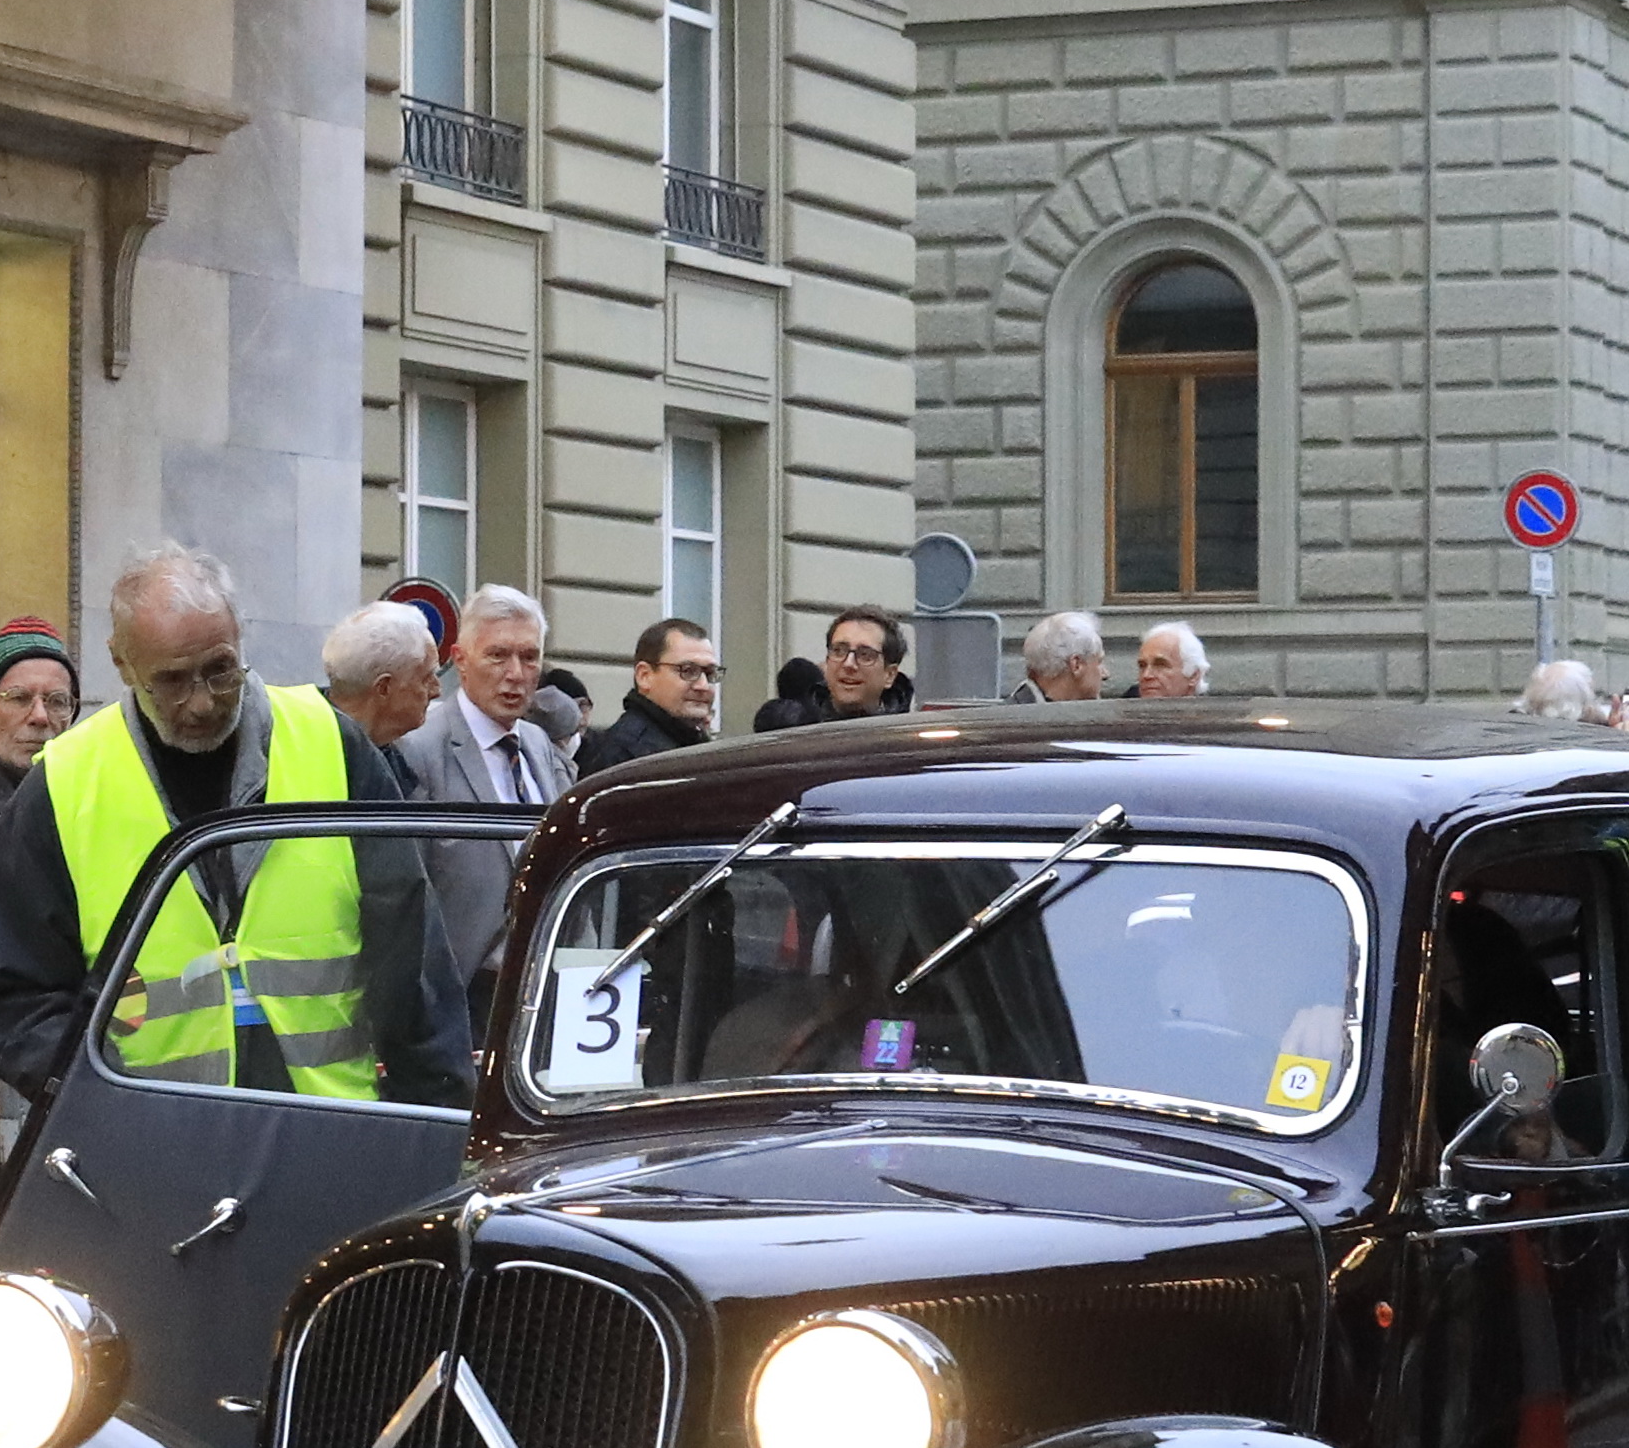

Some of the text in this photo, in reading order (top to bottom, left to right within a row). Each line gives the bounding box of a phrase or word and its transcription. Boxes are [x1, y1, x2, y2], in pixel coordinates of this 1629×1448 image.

[577, 983, 621, 1054] 3
[874, 1041, 900, 1064] 22
[1288, 1073, 1307, 1090] 12
